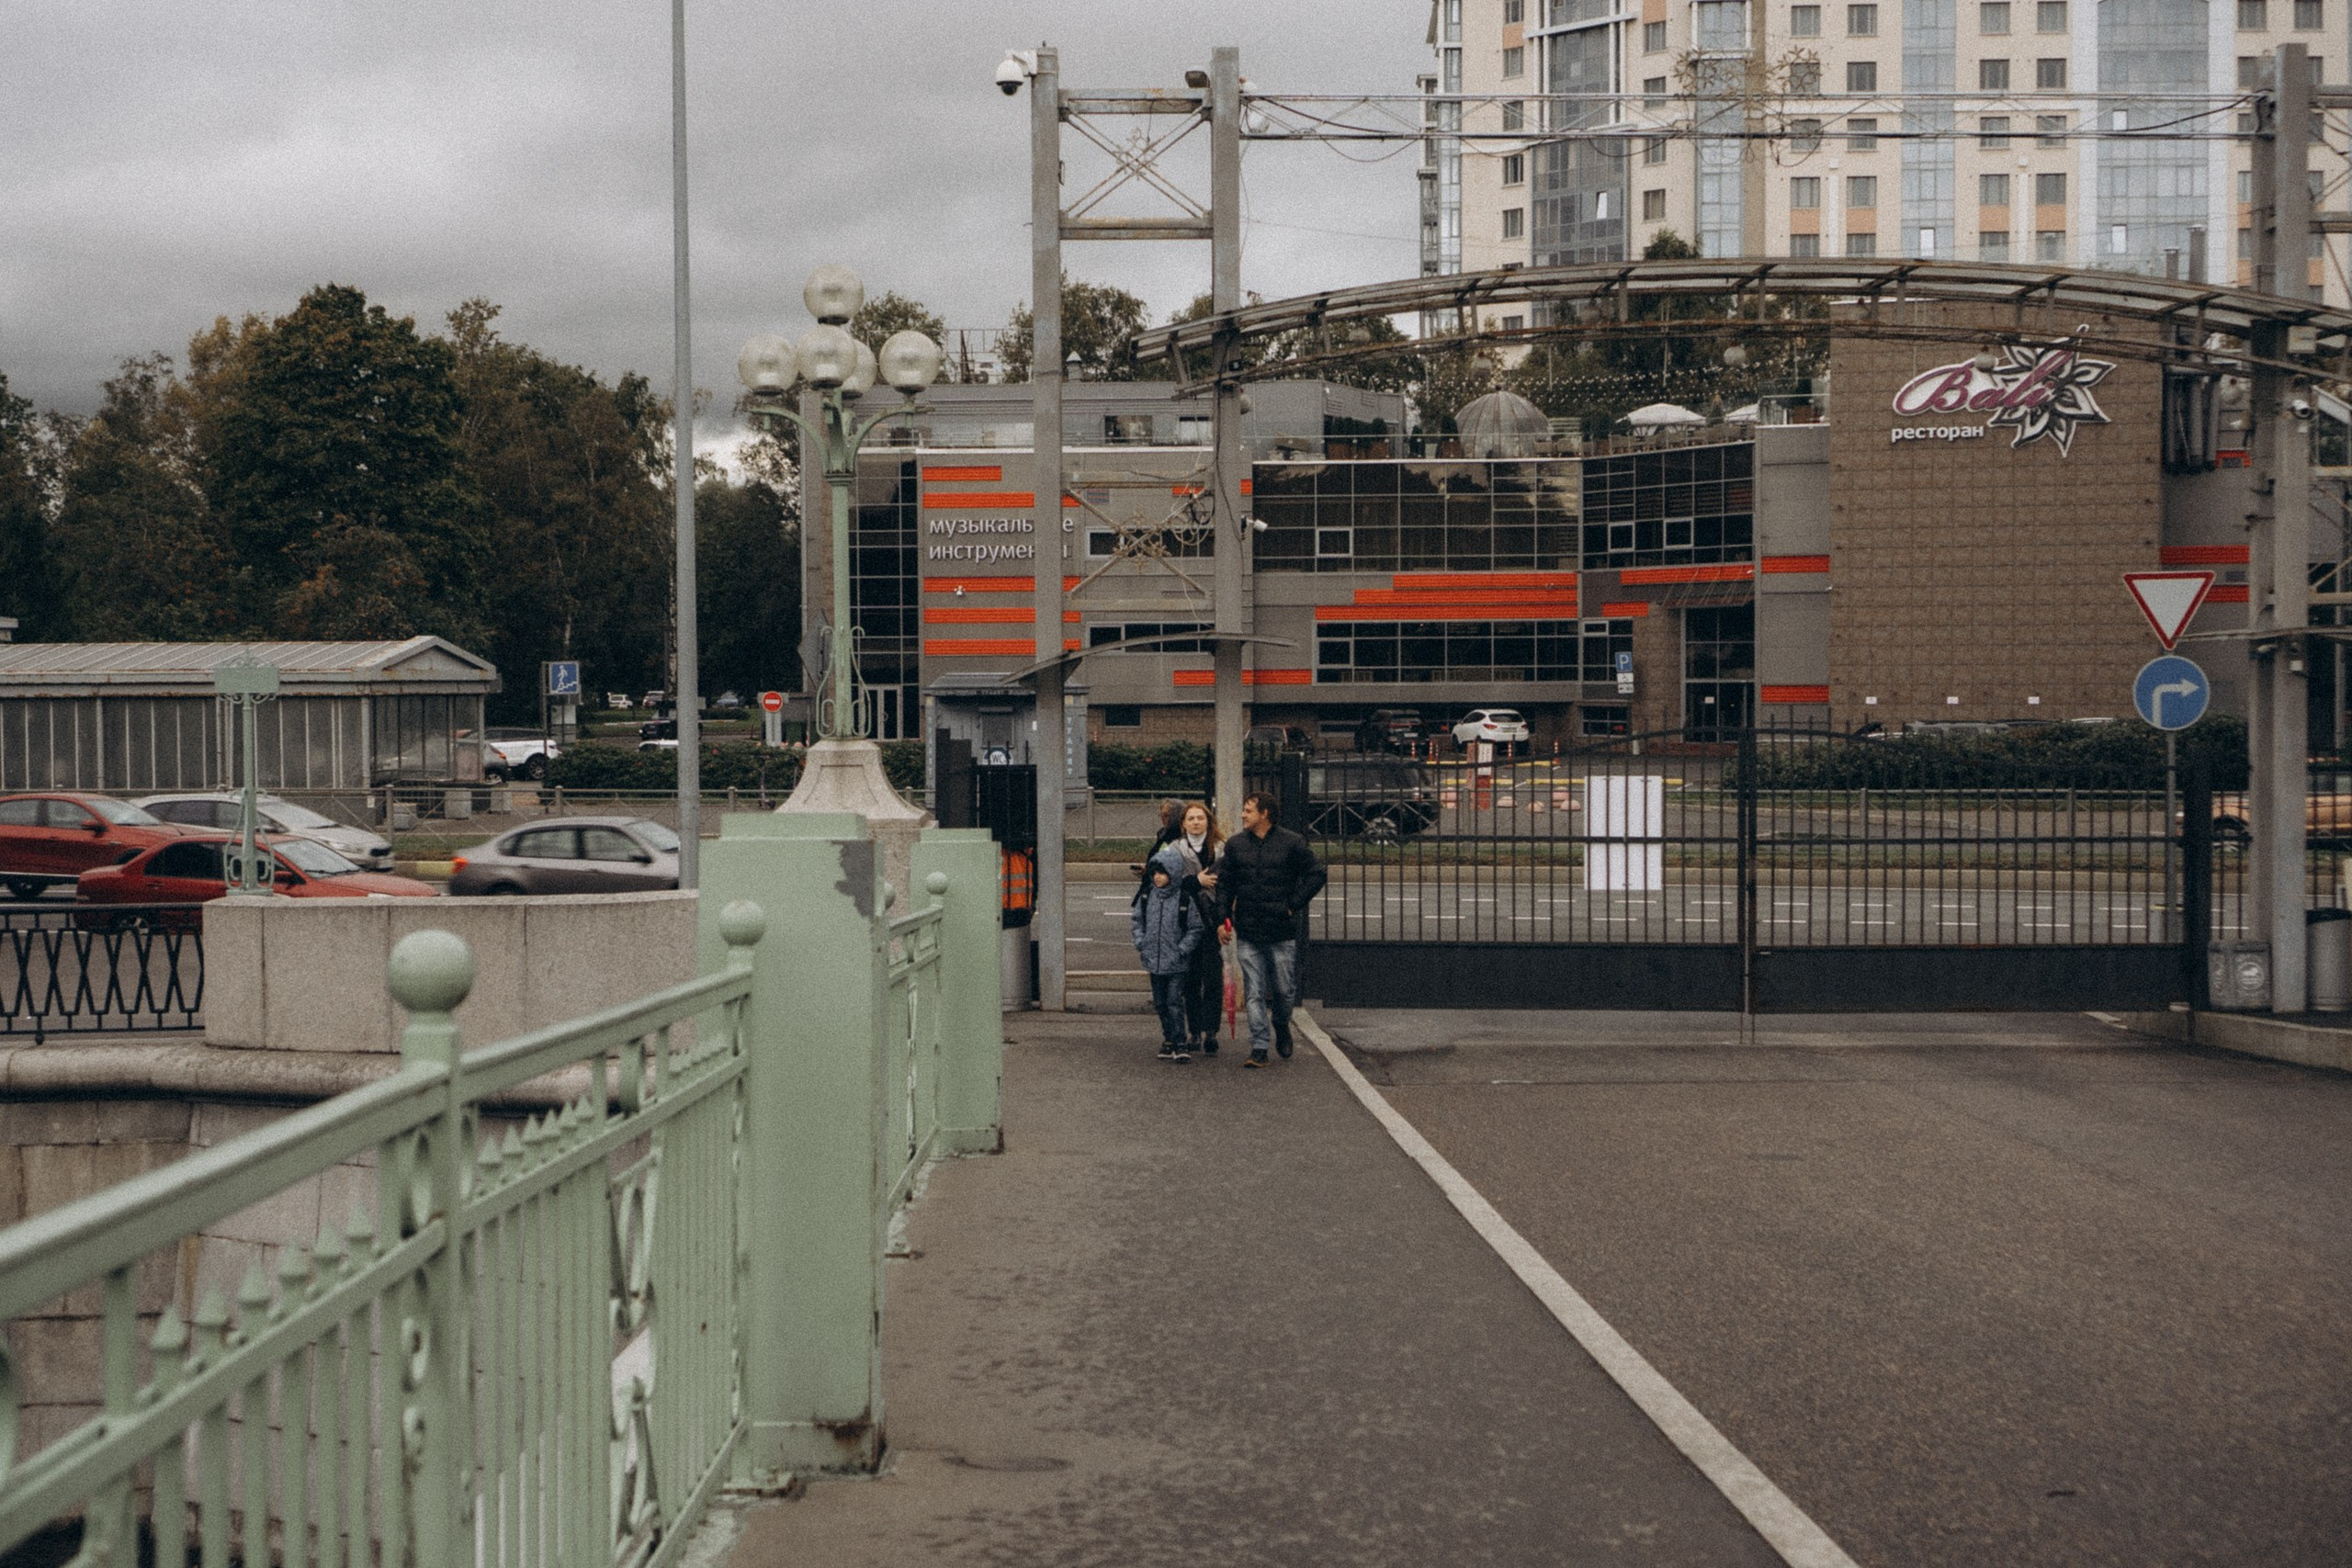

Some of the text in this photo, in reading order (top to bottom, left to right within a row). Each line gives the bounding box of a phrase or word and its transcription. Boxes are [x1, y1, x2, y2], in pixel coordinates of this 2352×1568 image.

[1894, 348, 2074, 412] Bali
[1892, 425, 1984, 443] ресторан
[929, 517, 1074, 538] музыкалье
[1620, 654, 1629, 670] P
